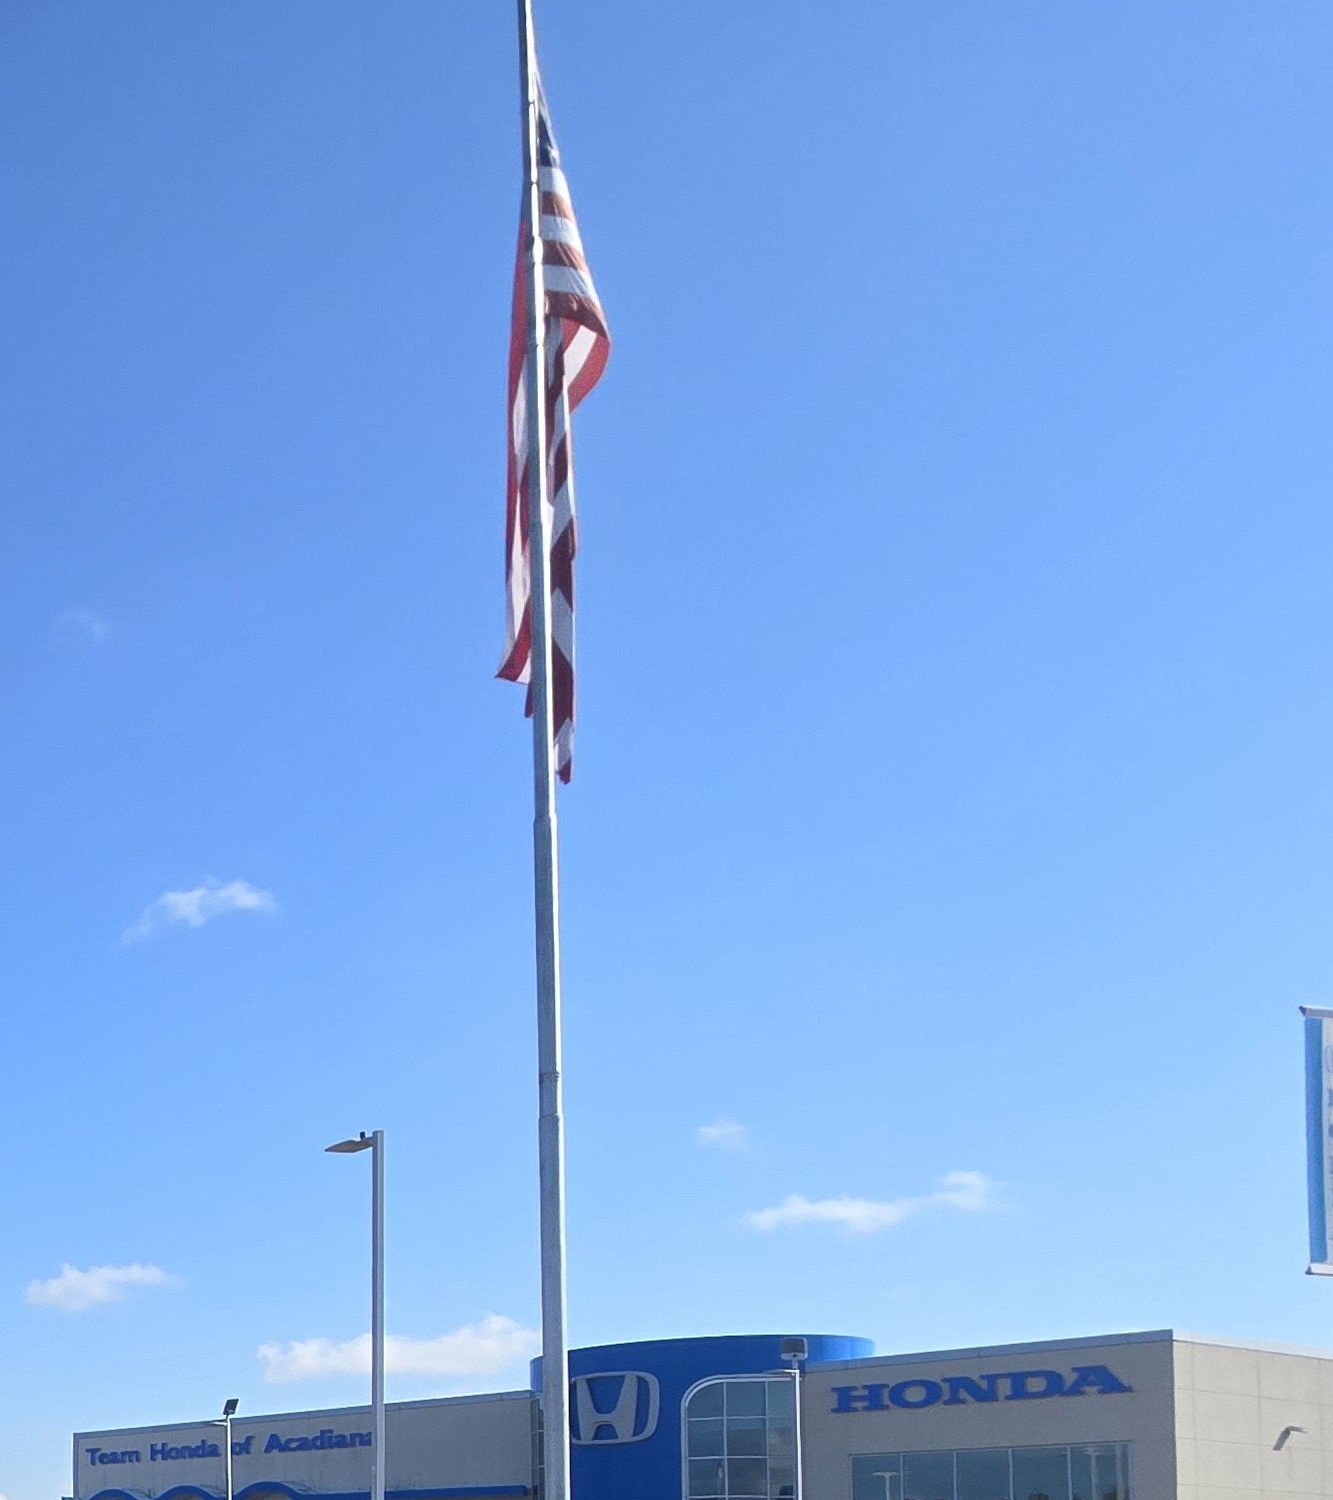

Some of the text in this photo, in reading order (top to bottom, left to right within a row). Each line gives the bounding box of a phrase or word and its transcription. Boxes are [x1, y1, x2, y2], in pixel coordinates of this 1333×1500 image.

[830, 1365, 1134, 1413] HONDA
[85, 1447, 141, 1466] Team
[149, 1440, 220, 1461] Honda
[232, 1435, 254, 1455] of
